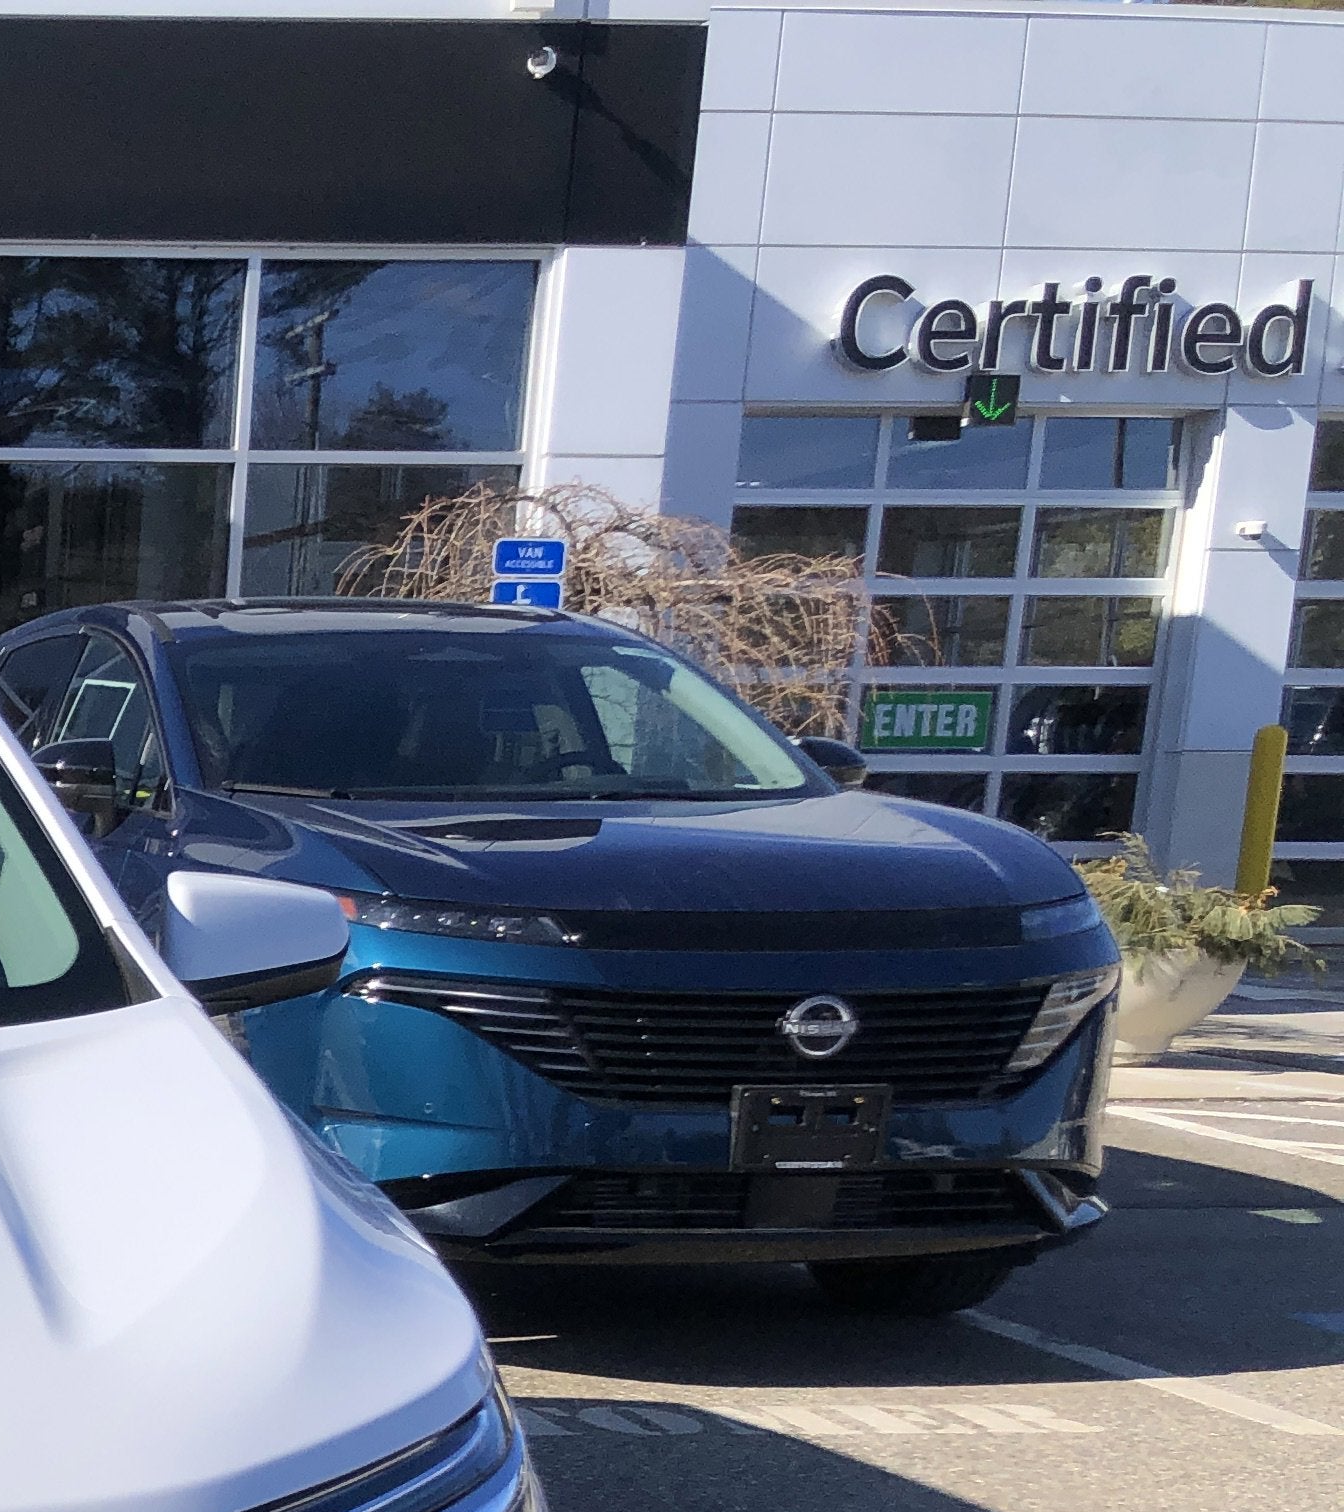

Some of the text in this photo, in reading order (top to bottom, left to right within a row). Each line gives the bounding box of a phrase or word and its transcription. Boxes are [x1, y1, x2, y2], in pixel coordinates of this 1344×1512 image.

[840, 273, 1316, 378] Certified
[517, 546, 544, 559] VAN
[874, 703, 978, 737] ENTER
